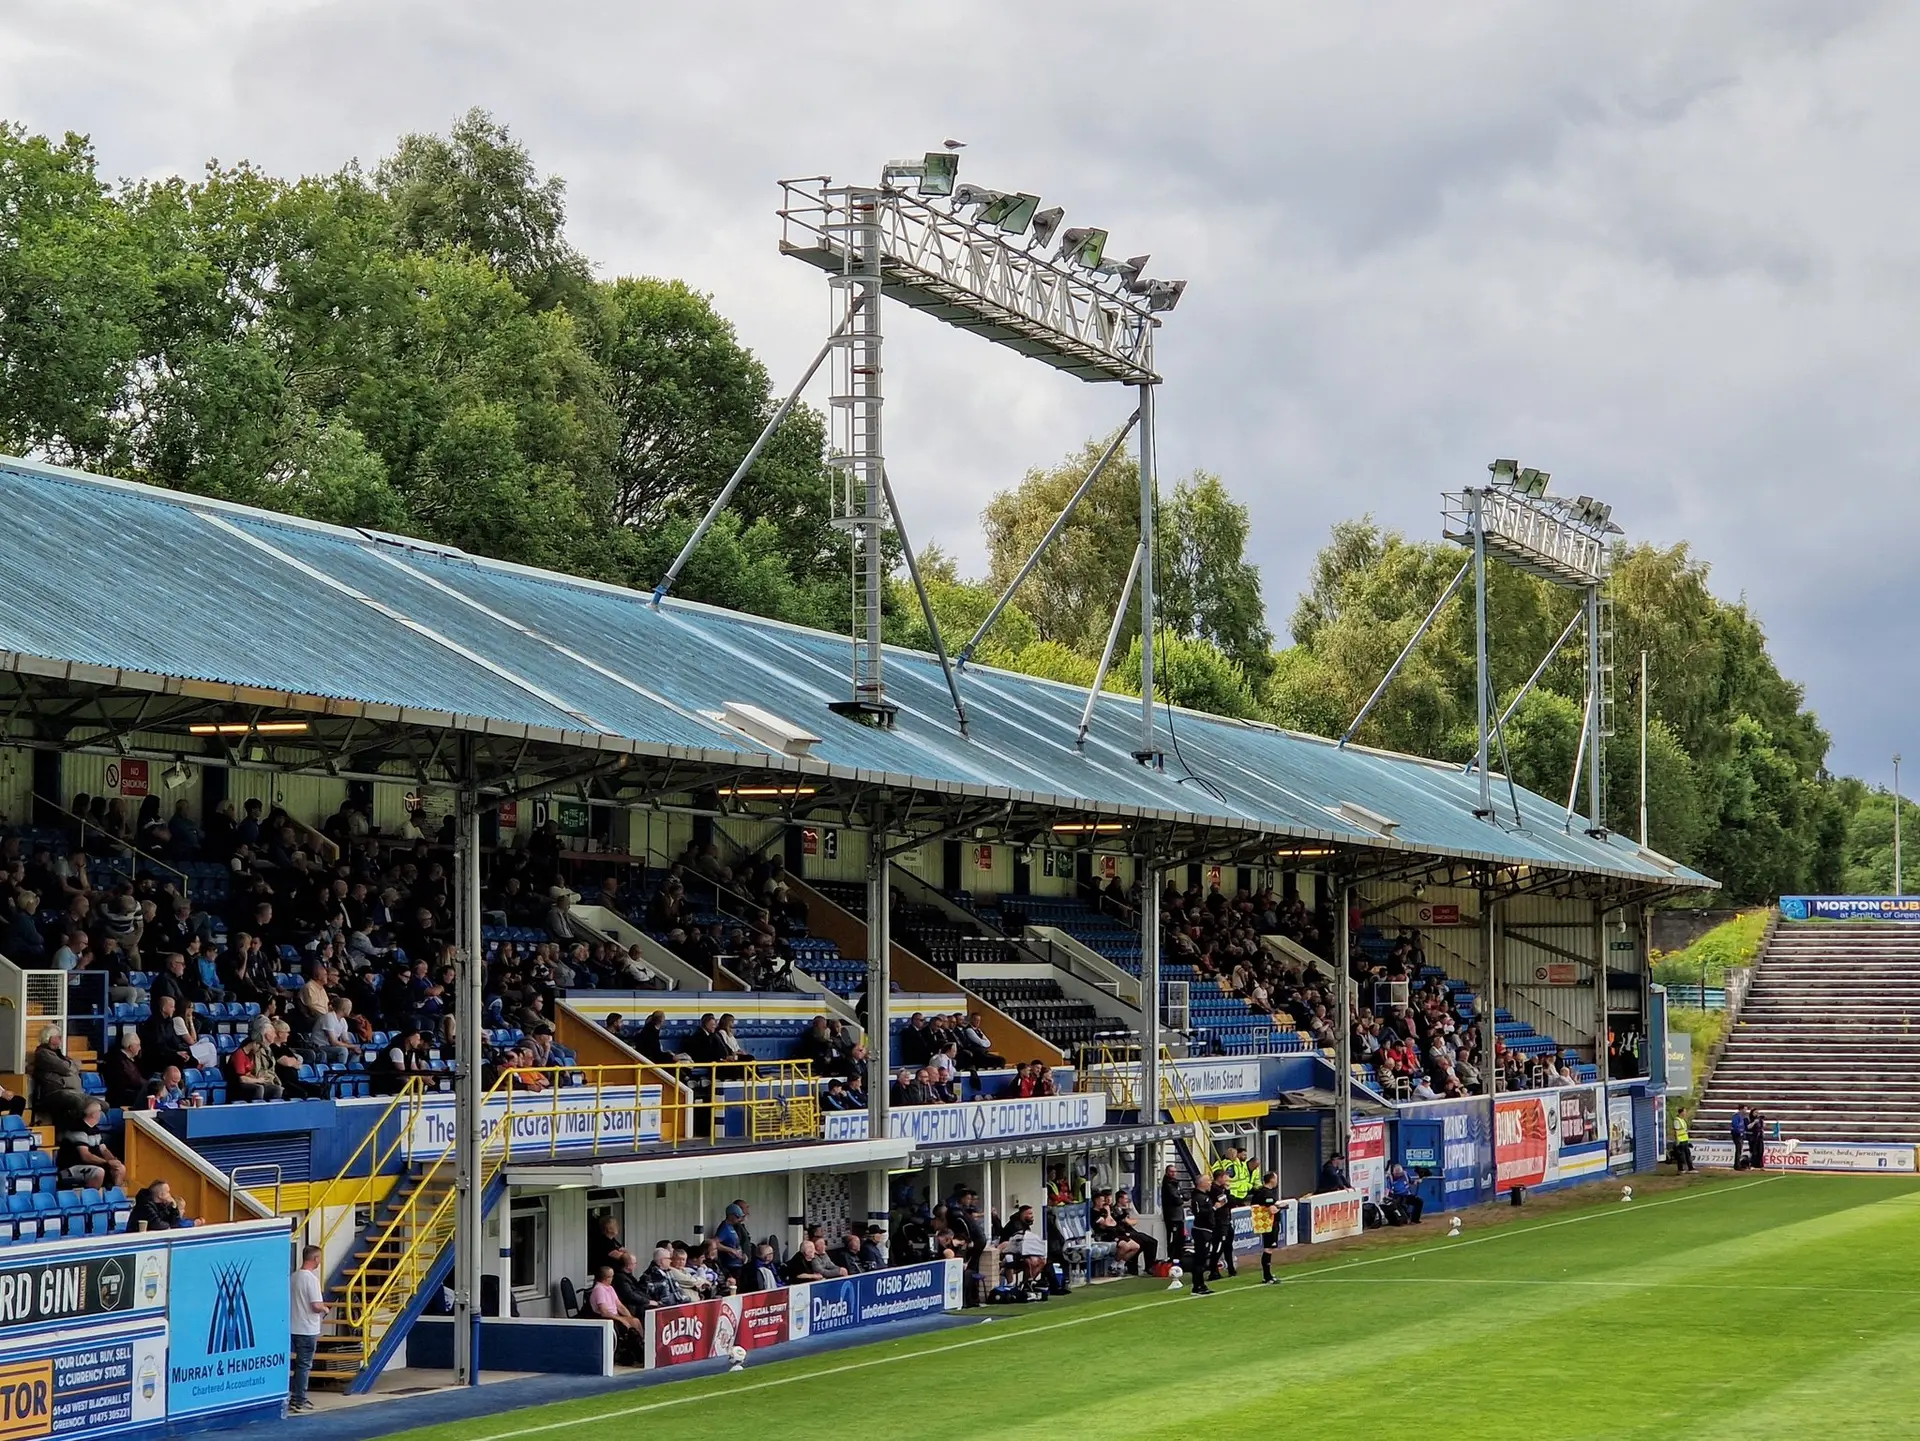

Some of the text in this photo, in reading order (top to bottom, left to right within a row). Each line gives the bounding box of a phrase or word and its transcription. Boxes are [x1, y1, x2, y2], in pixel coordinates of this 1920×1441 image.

[131, 767, 139, 776] NO
[536, 802, 546, 828] D
[1816, 901, 1879, 911] MORTON
[1840, 911, 1848, 919] at
[1850, 911, 1881, 919] Smiths
[1883, 911, 1892, 919] of
[1203, 1070, 1221, 1092] Main
[1222, 1068, 1244, 1090] Stand
[426, 1113, 455, 1143] The
[565, 1106, 598, 1134] Main
[603, 1102, 642, 1132] Stand
[829, 1099, 1089, 1142] GREECK MORTON FOOTBALL CLUB
[1764, 1155, 1808, 1165] ERSTORE
[1855, 1149, 1887, 1157] furniture
[40, 1266, 80, 1315] GIN
[79, 1265, 87, 1310] ORIGINAL
[876, 1269, 932, 1297] 01506 239600
[744, 1303, 788, 1319] OFFICIAL SPIRIT
[813, 1297, 848, 1322] Dalrada
[861, 1294, 942, 1320] info@dalradatechnology.com
[662, 1315, 703, 1346] GLEN'S
[748, 1315, 784, 1329] OF THE SPFL
[812, 1315, 854, 1332] TECHNOLOGY
[54, 1347, 132, 1371] YOUR LOCAL BUY, SELL
[670, 1342, 695, 1356] VODKA
[58, 1364, 127, 1387] & CURRENCY STORE
[171, 1352, 286, 1384] MURRAY & HENDERSON
[192, 1376, 266, 1397] Chartered Accountants
[0, 1379, 47, 1421] TOR
[53, 1392, 131, 1416] 61-63 WEST BLACKHALL ST
[53, 1407, 131, 1431] GREENOCK 01475 305221
